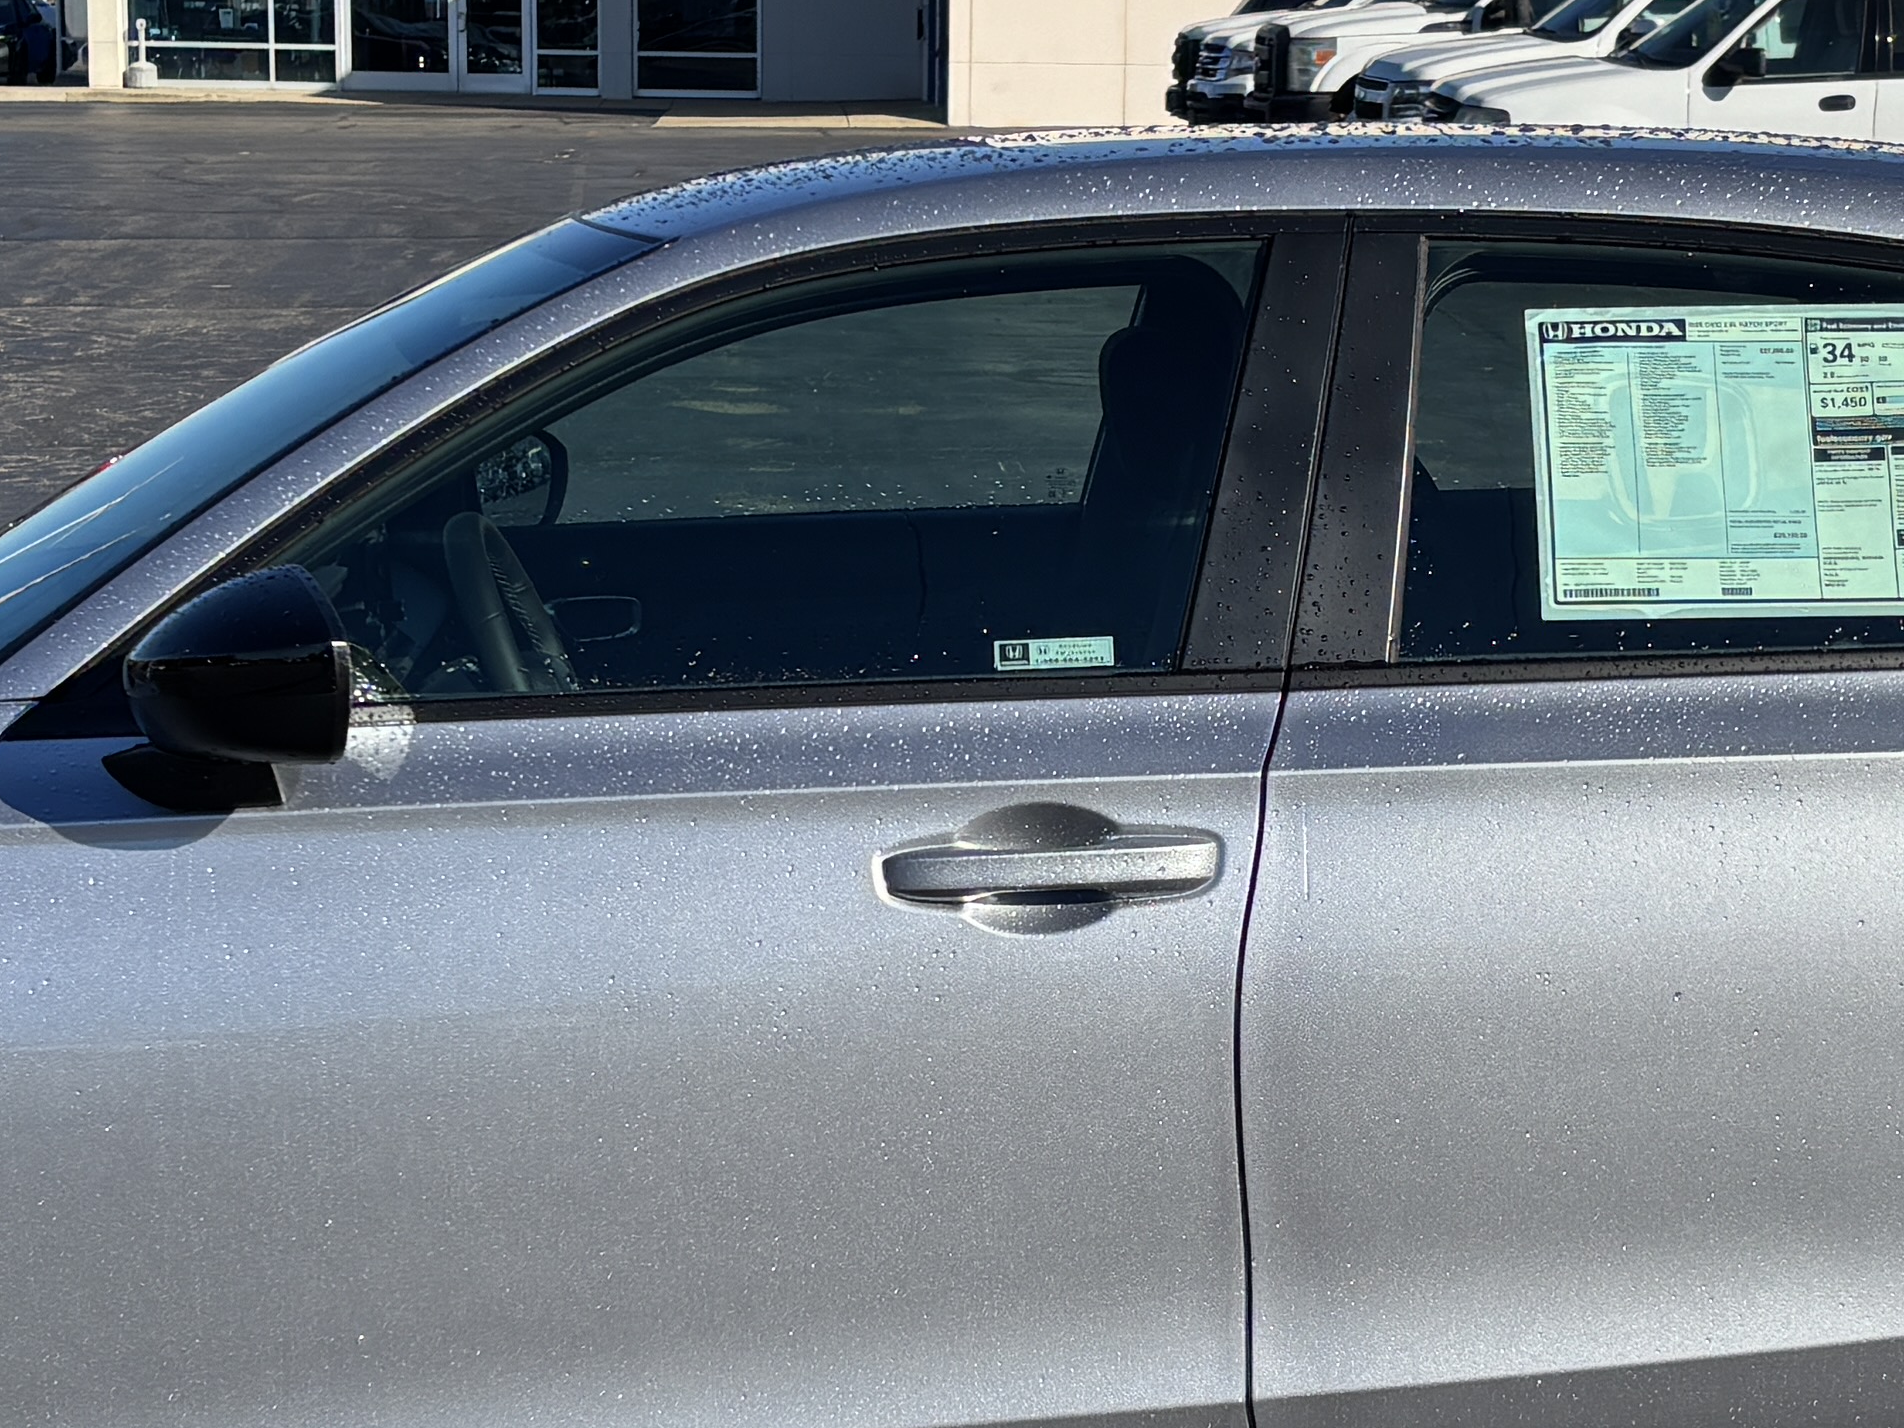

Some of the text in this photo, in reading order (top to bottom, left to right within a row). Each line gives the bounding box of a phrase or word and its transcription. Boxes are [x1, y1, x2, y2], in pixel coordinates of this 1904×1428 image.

[1571, 320, 1684, 338] HONDA
[1822, 342, 1856, 363] 34
[1819, 395, 1868, 410] $1,450
